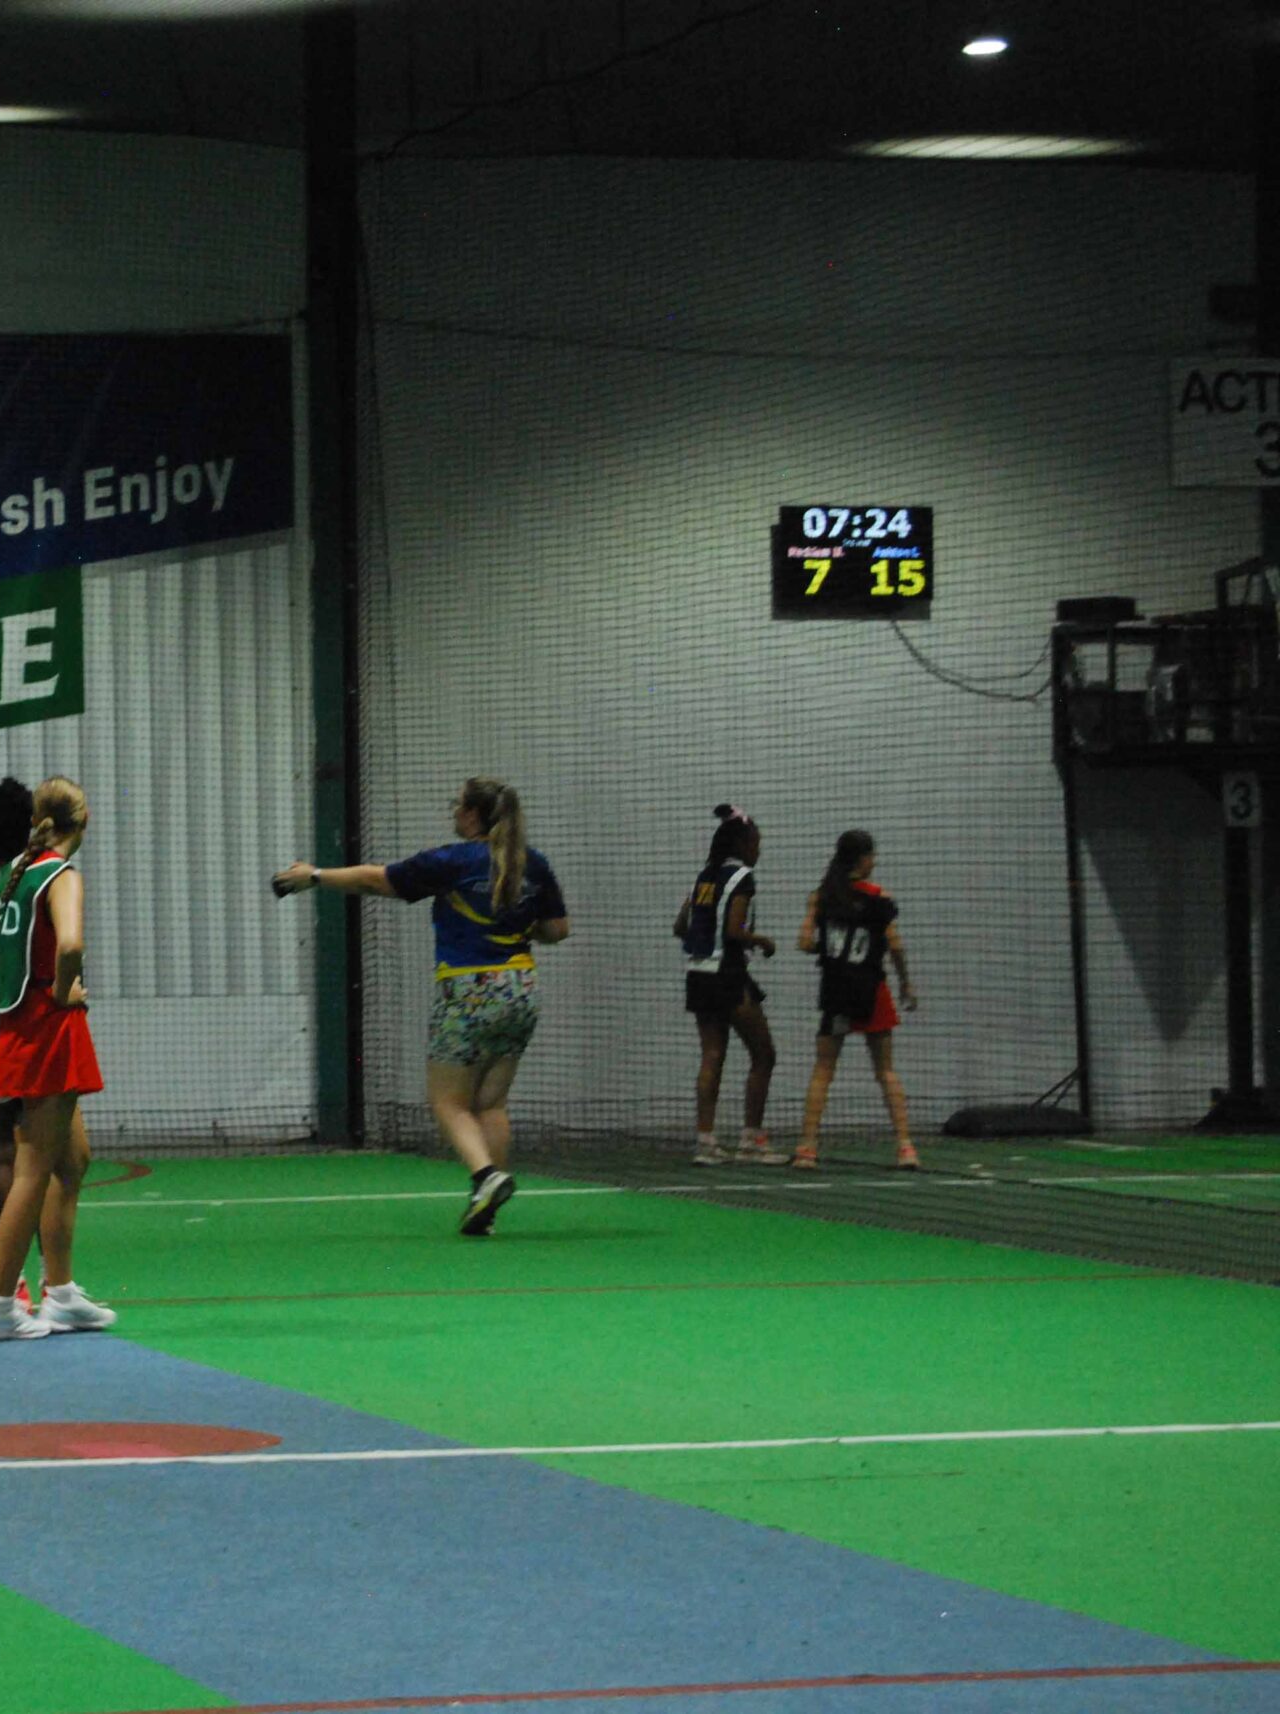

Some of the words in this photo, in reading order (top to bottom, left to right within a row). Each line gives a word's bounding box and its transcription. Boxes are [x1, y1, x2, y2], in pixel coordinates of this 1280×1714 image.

[1180, 370, 1280, 413] ACT
[1256, 421, 1280, 478] 3
[84, 455, 235, 523] Enjoy
[803, 507, 912, 538] 07:24
[803, 559, 832, 595] 7
[870, 559, 926, 596] 15
[1231, 781, 1252, 819] 3
